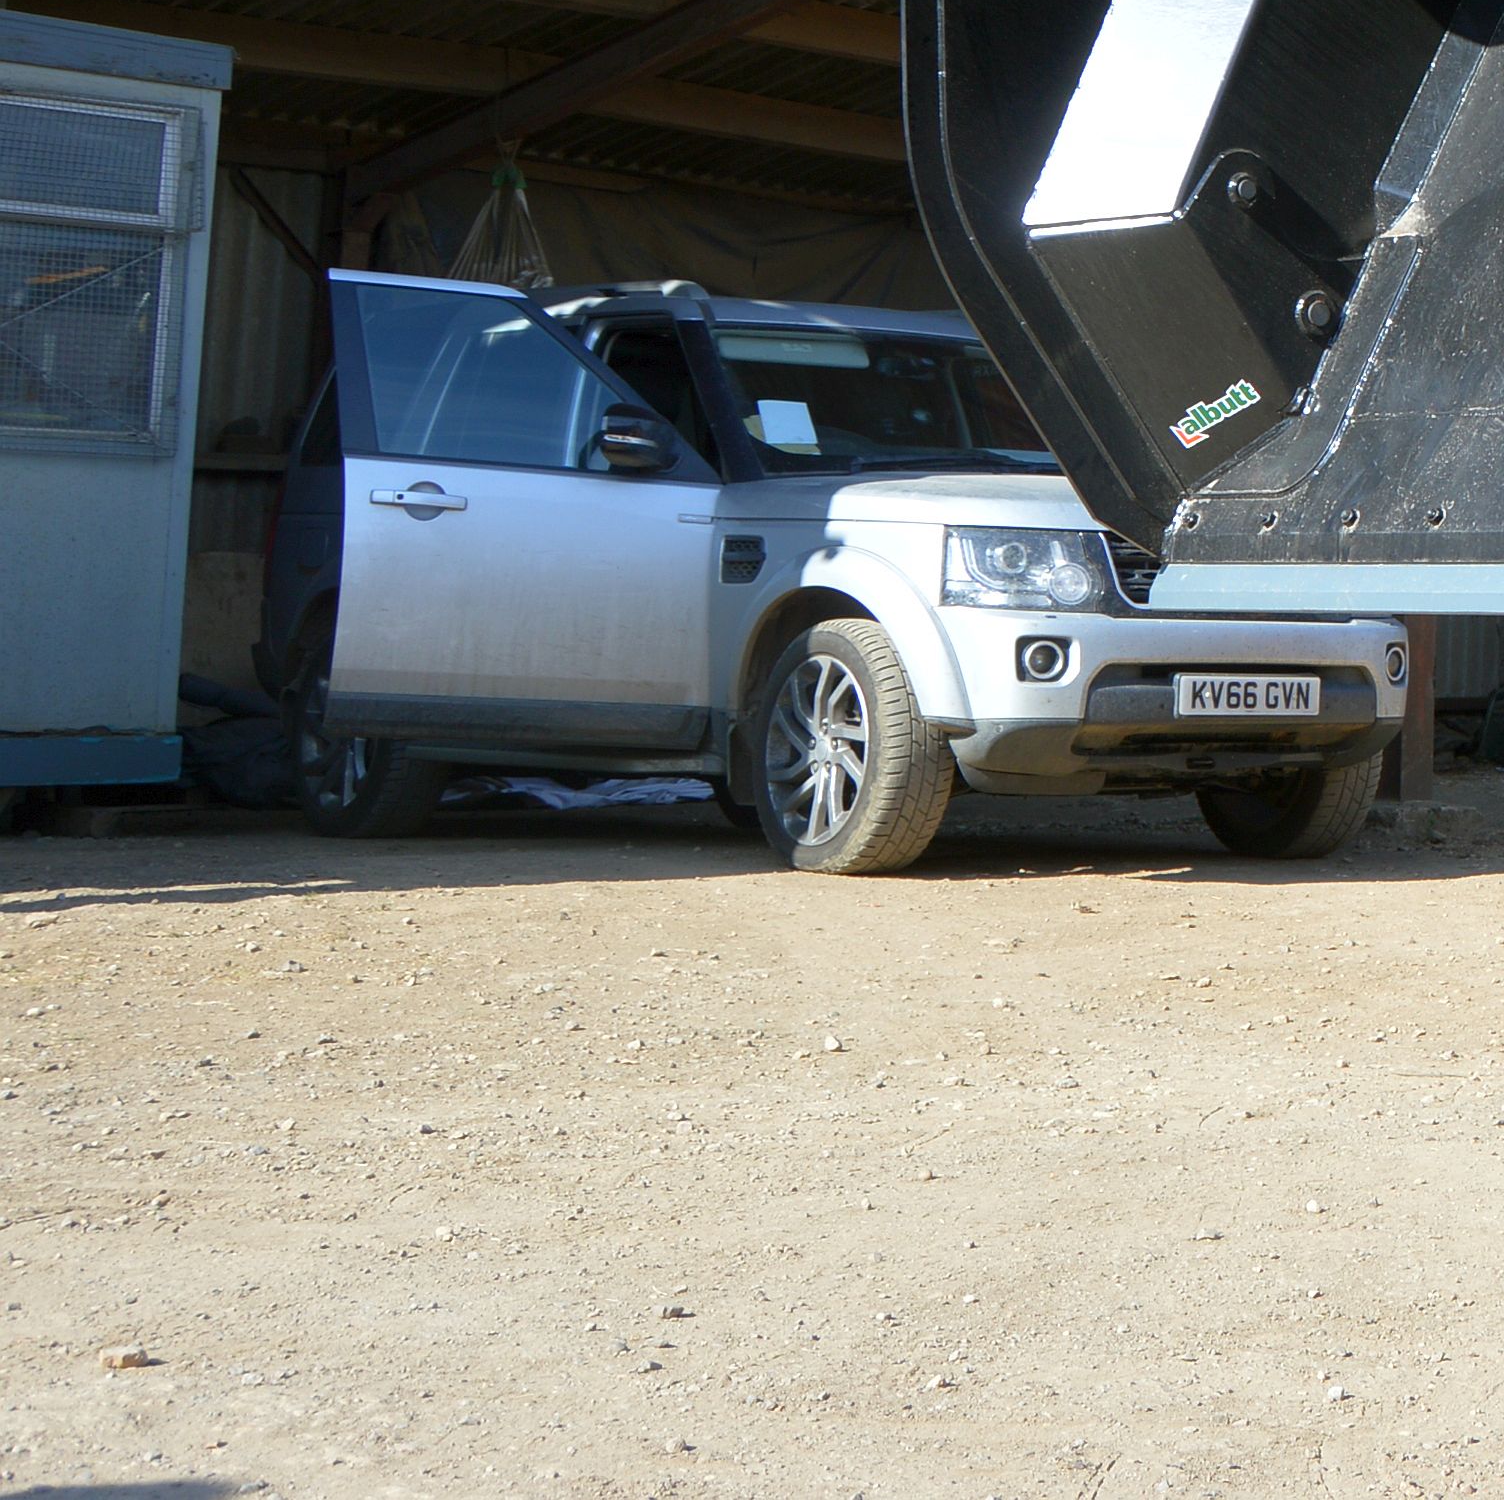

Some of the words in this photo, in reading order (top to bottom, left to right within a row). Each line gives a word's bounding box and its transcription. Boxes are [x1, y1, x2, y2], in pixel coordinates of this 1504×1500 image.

[1179, 381, 1260, 436] albutt
[1191, 680, 1258, 709] KV66
[1265, 681, 1311, 710] GVN
